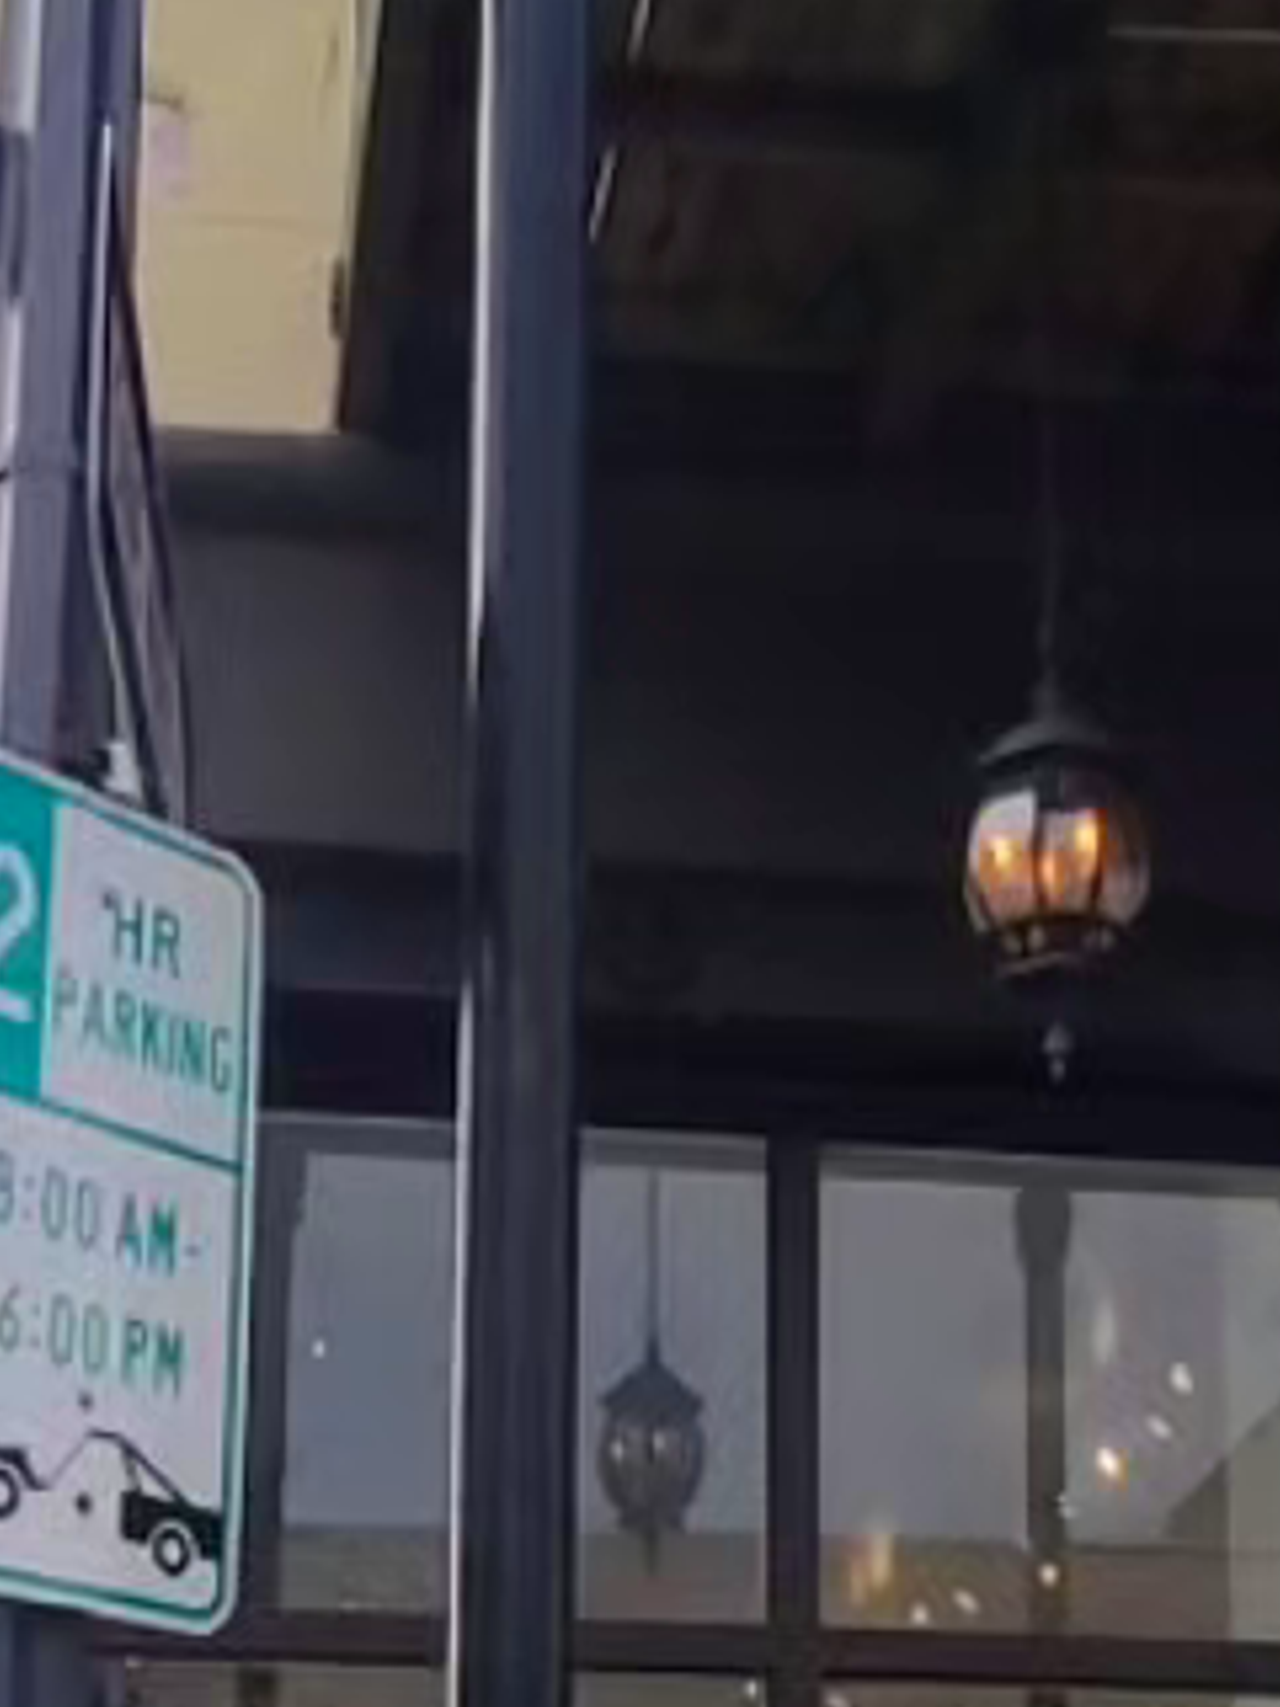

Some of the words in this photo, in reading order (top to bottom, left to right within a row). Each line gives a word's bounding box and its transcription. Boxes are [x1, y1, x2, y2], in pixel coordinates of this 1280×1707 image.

[111, 897, 181, 980] HR
[54, 967, 233, 1094] PARKING
[122, 1315, 182, 1400] PM
